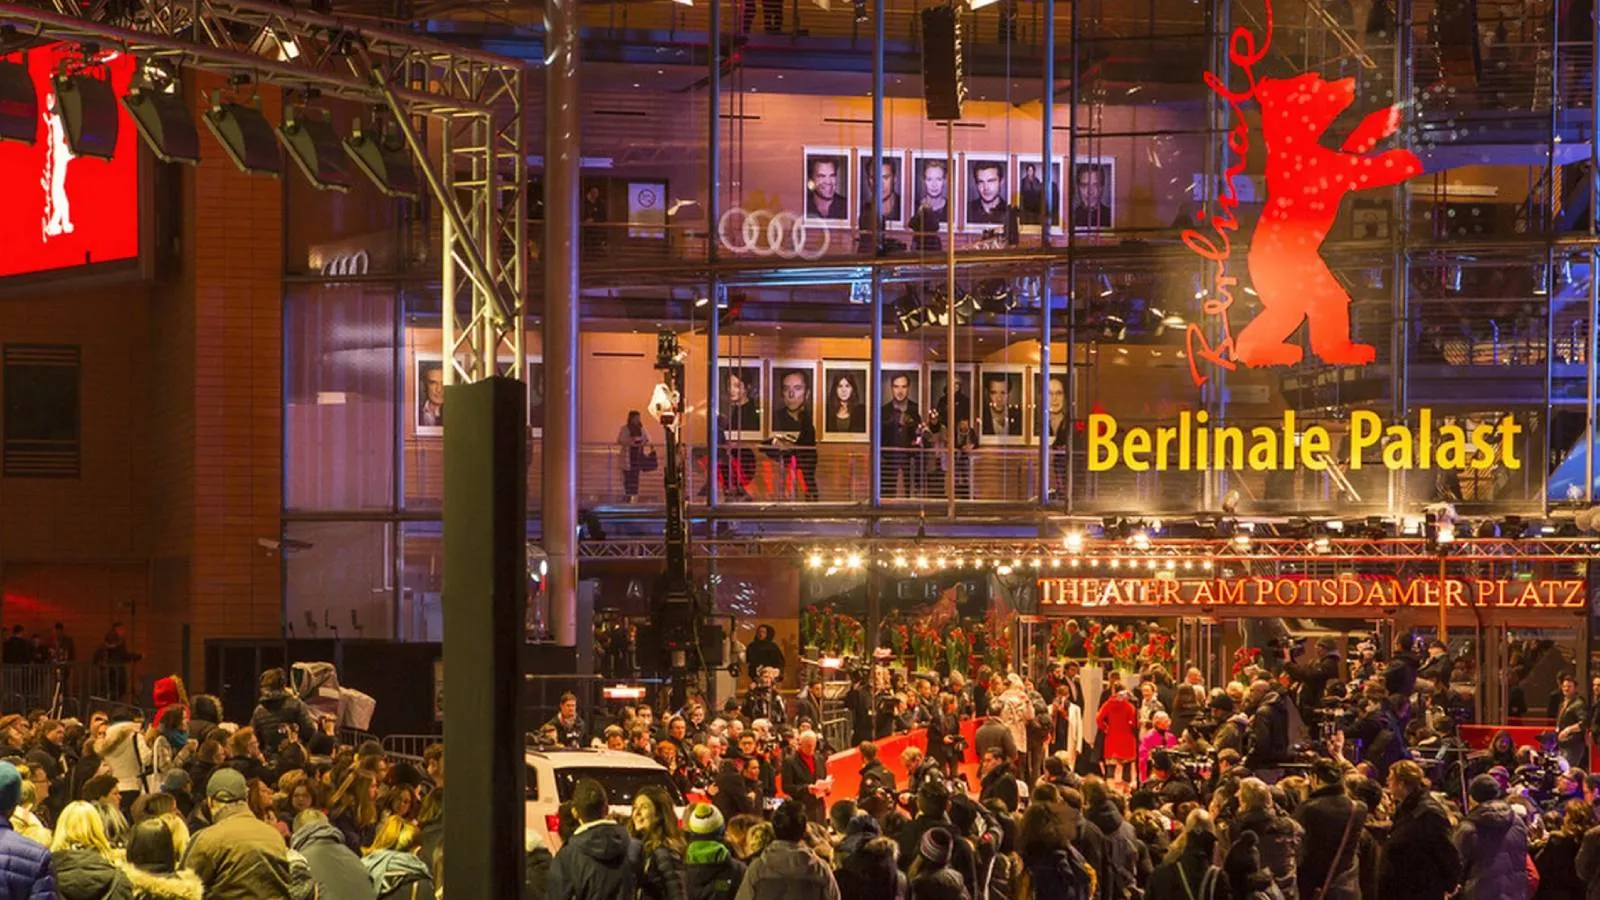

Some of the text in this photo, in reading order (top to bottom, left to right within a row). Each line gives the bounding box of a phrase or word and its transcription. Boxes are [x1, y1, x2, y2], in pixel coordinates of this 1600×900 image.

[1181, 0, 1273, 387] Berlinale
[1087, 408, 1521, 472] Berlinale Palast
[1037, 578, 1184, 606] THEATER
[1192, 578, 1249, 604] AM
[1253, 578, 1468, 606] POTSDAMER
[1475, 579, 1586, 607] PLATZ
